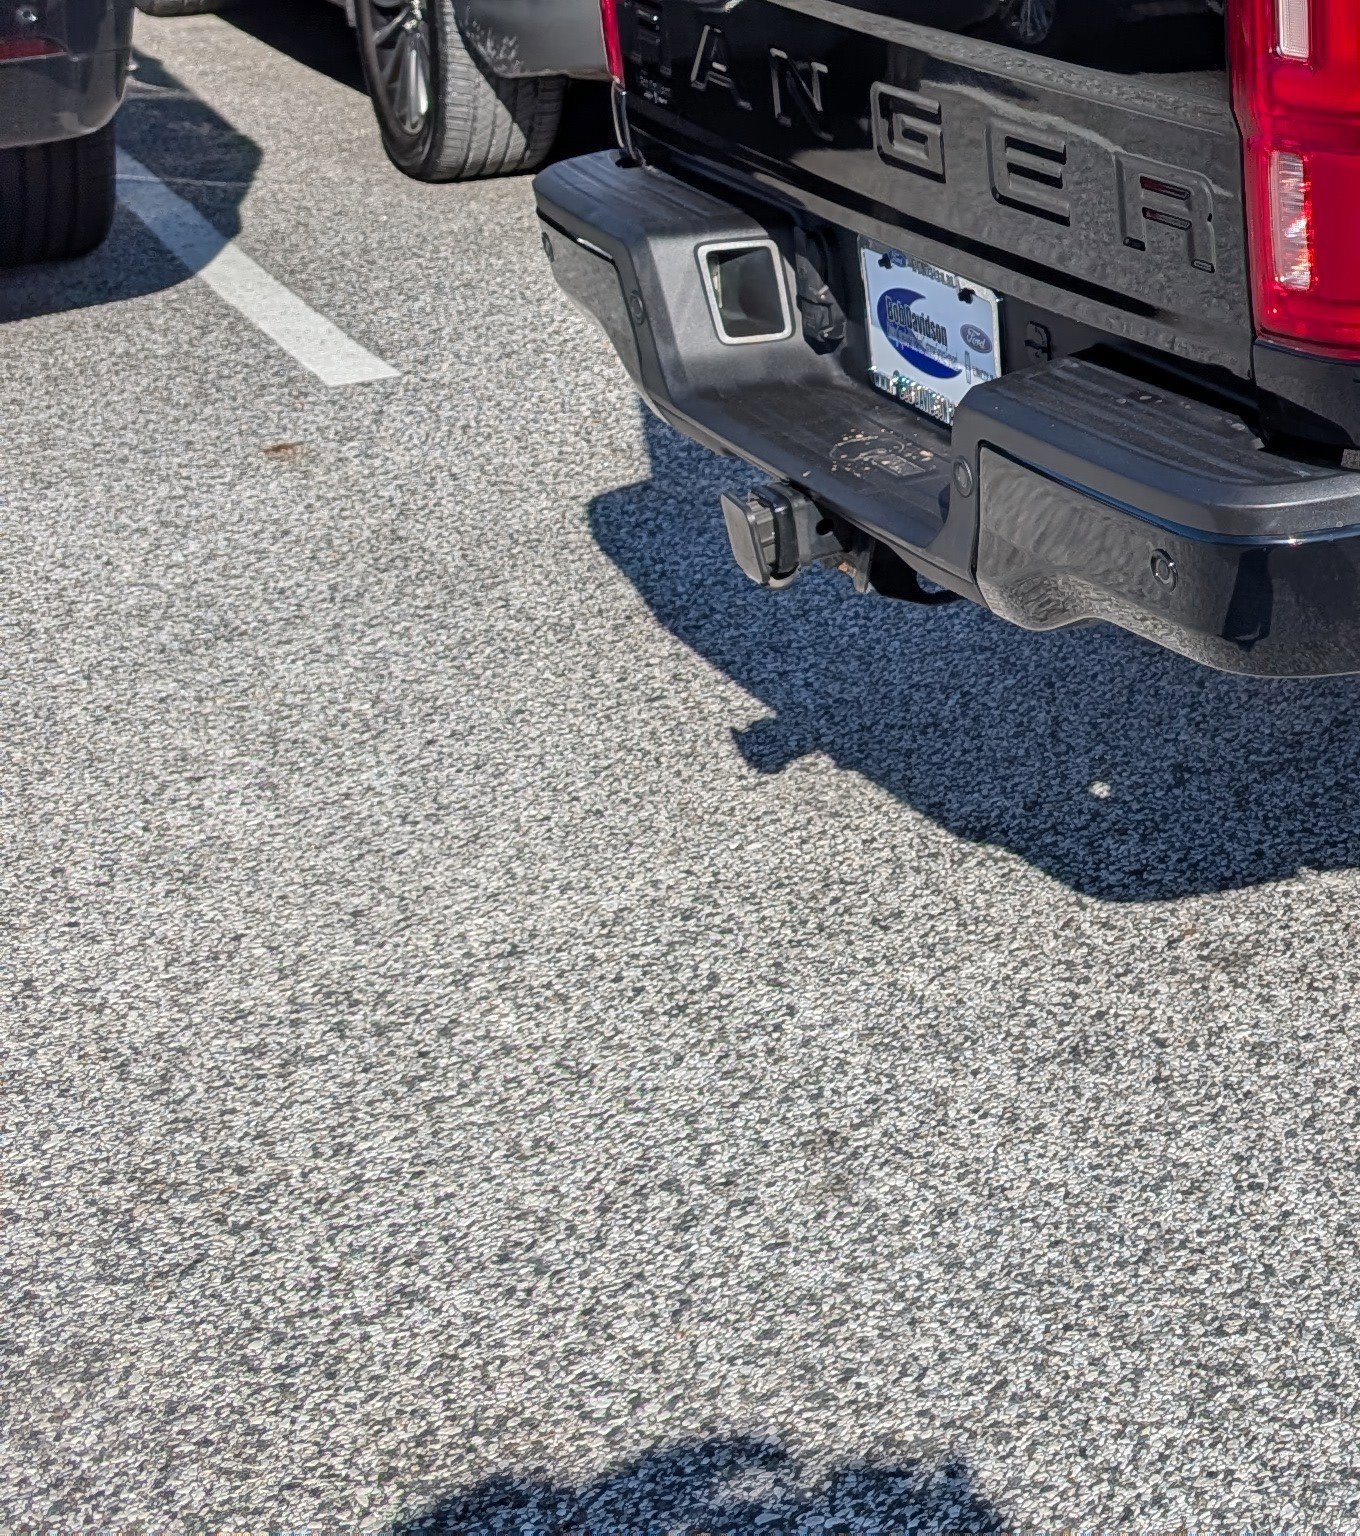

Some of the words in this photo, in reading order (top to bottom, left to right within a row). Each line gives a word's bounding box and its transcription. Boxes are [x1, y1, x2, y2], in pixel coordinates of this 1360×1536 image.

[885, 295, 907, 325] Bob
[906, 306, 949, 347] Davidson
[963, 327, 989, 351] Ford
